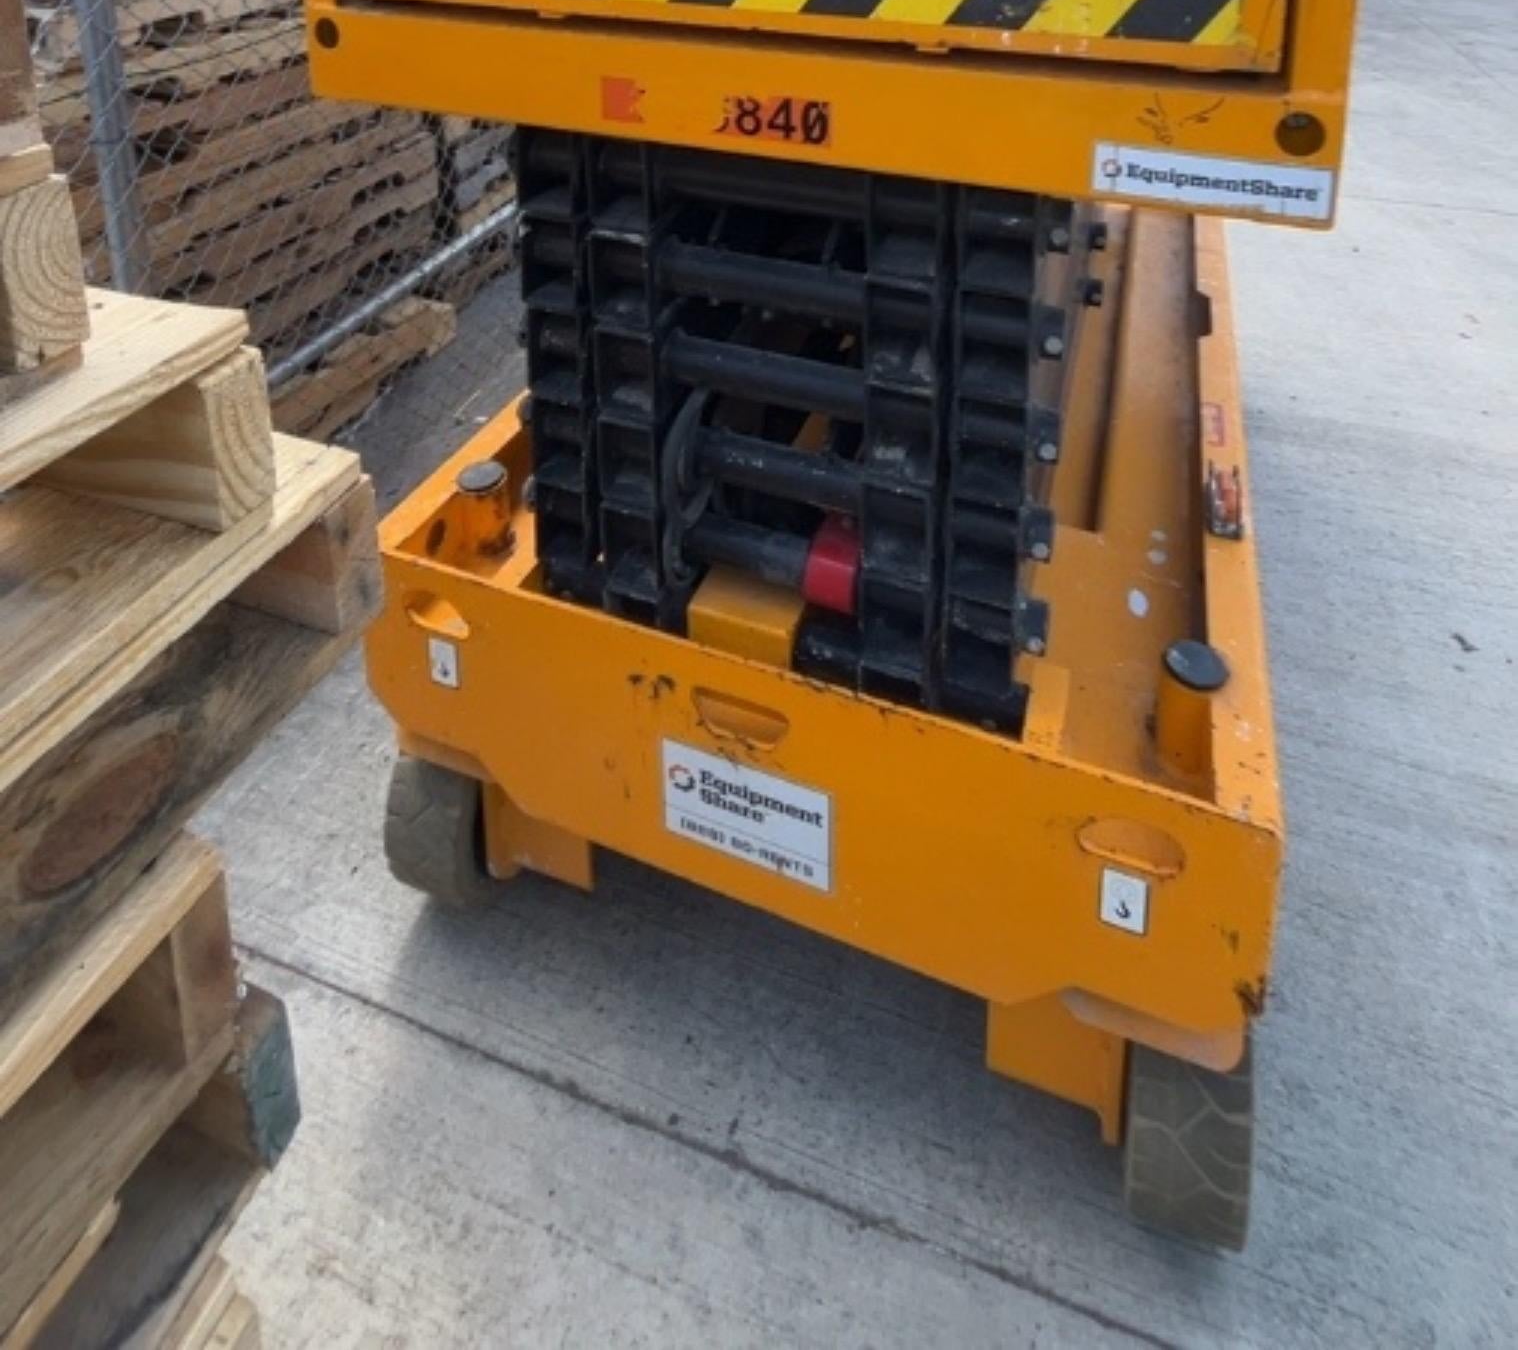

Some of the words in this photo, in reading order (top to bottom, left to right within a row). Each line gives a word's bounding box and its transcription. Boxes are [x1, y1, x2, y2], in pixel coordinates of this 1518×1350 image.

[1126, 162, 1319, 201] EquipmentShare
[700, 769, 823, 828] Equipment
[700, 788, 765, 824] Share
